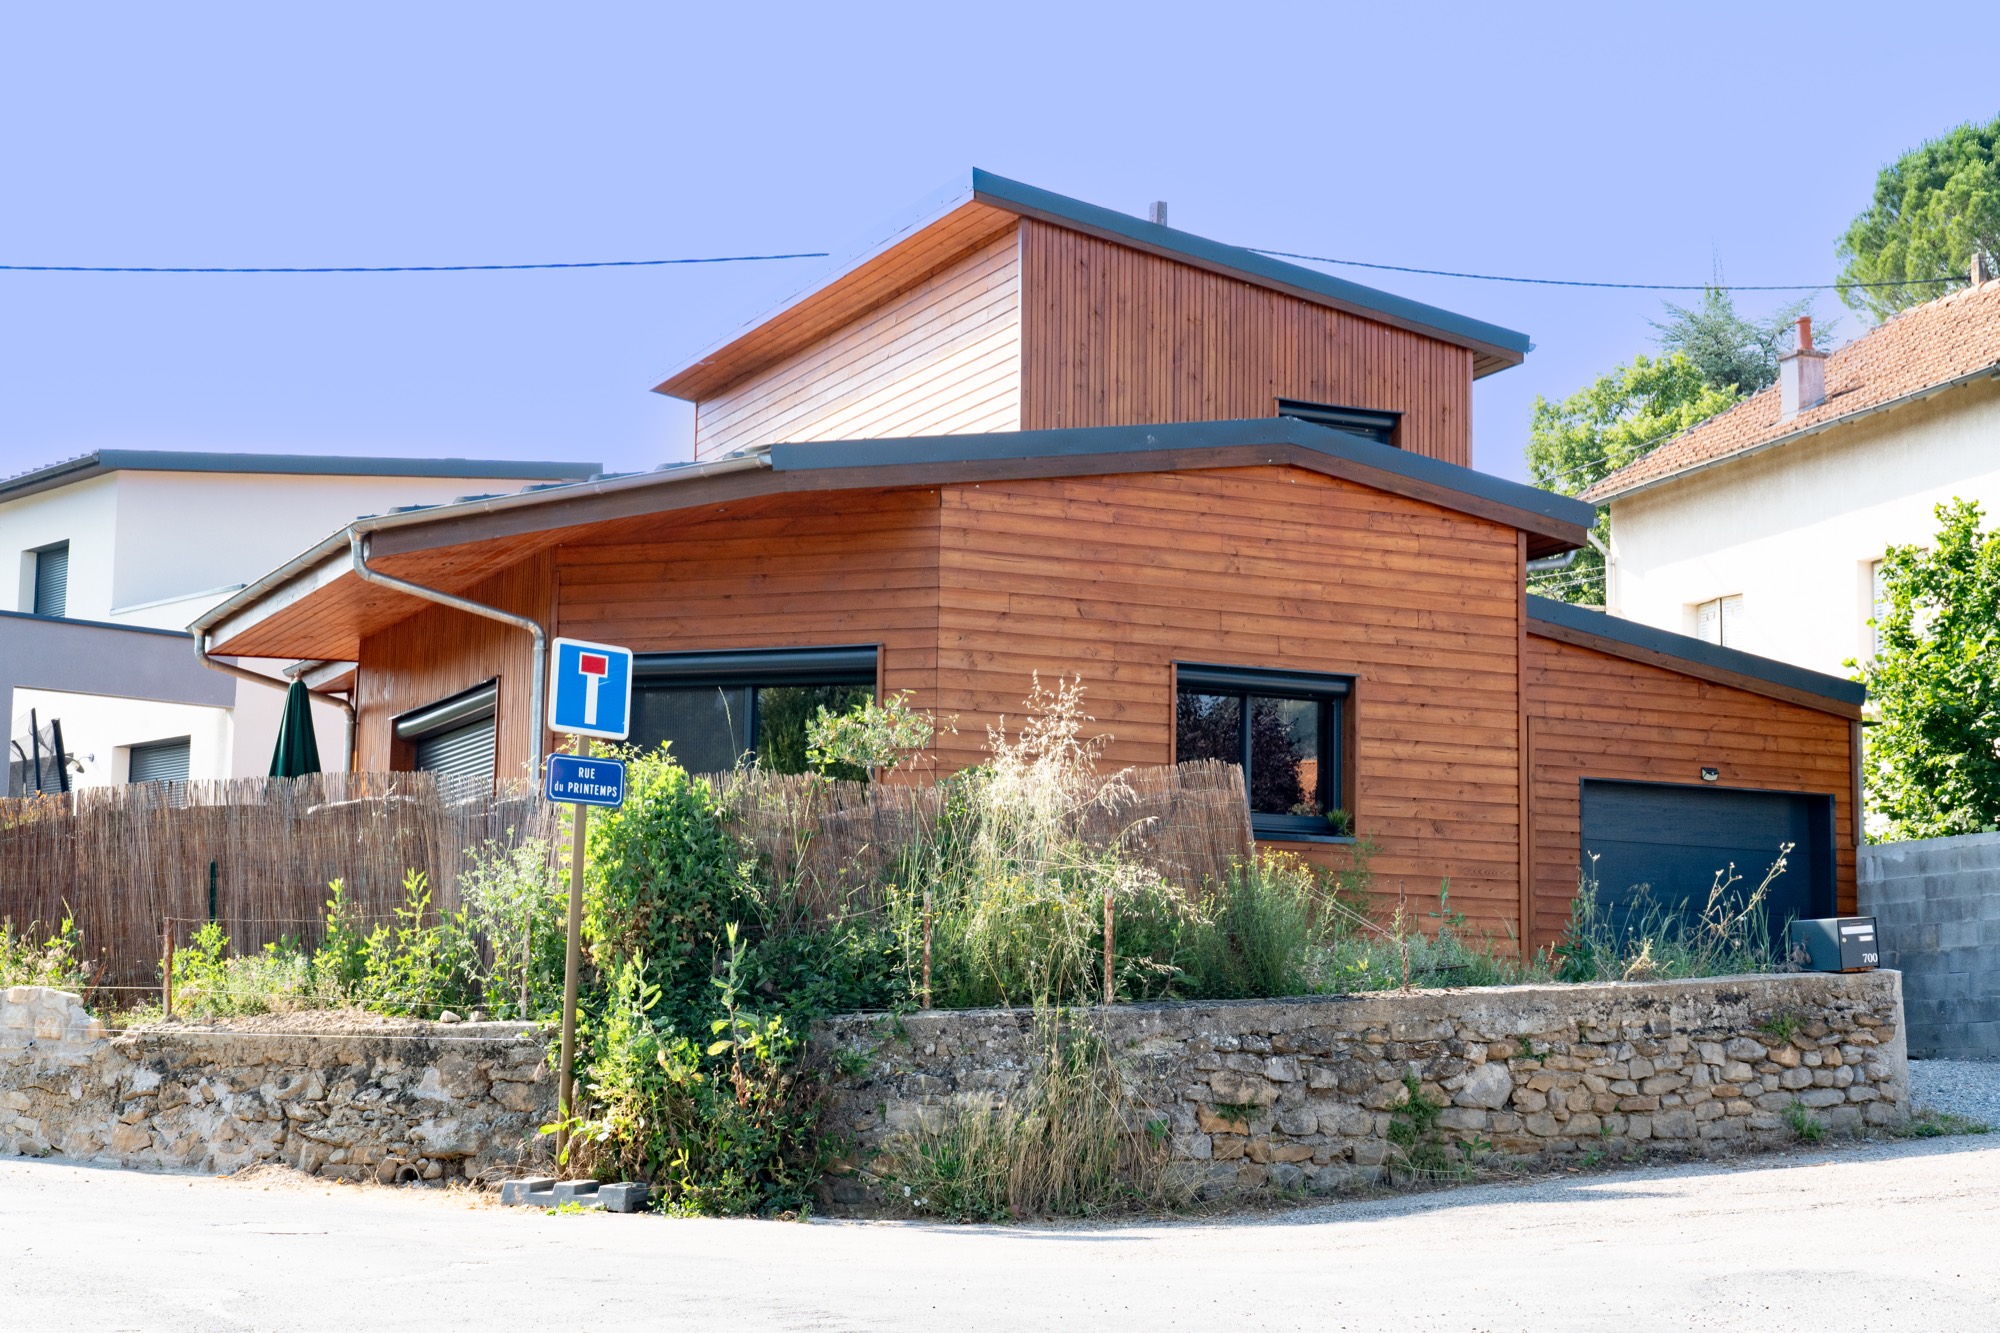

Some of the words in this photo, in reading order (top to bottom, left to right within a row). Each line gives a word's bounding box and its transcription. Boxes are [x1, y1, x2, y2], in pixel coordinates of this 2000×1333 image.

[578, 767, 595, 779] RUE
[554, 781, 564, 791] du
[567, 782, 617, 797] PRINTEMPS
[1862, 953, 1878, 963] 700
